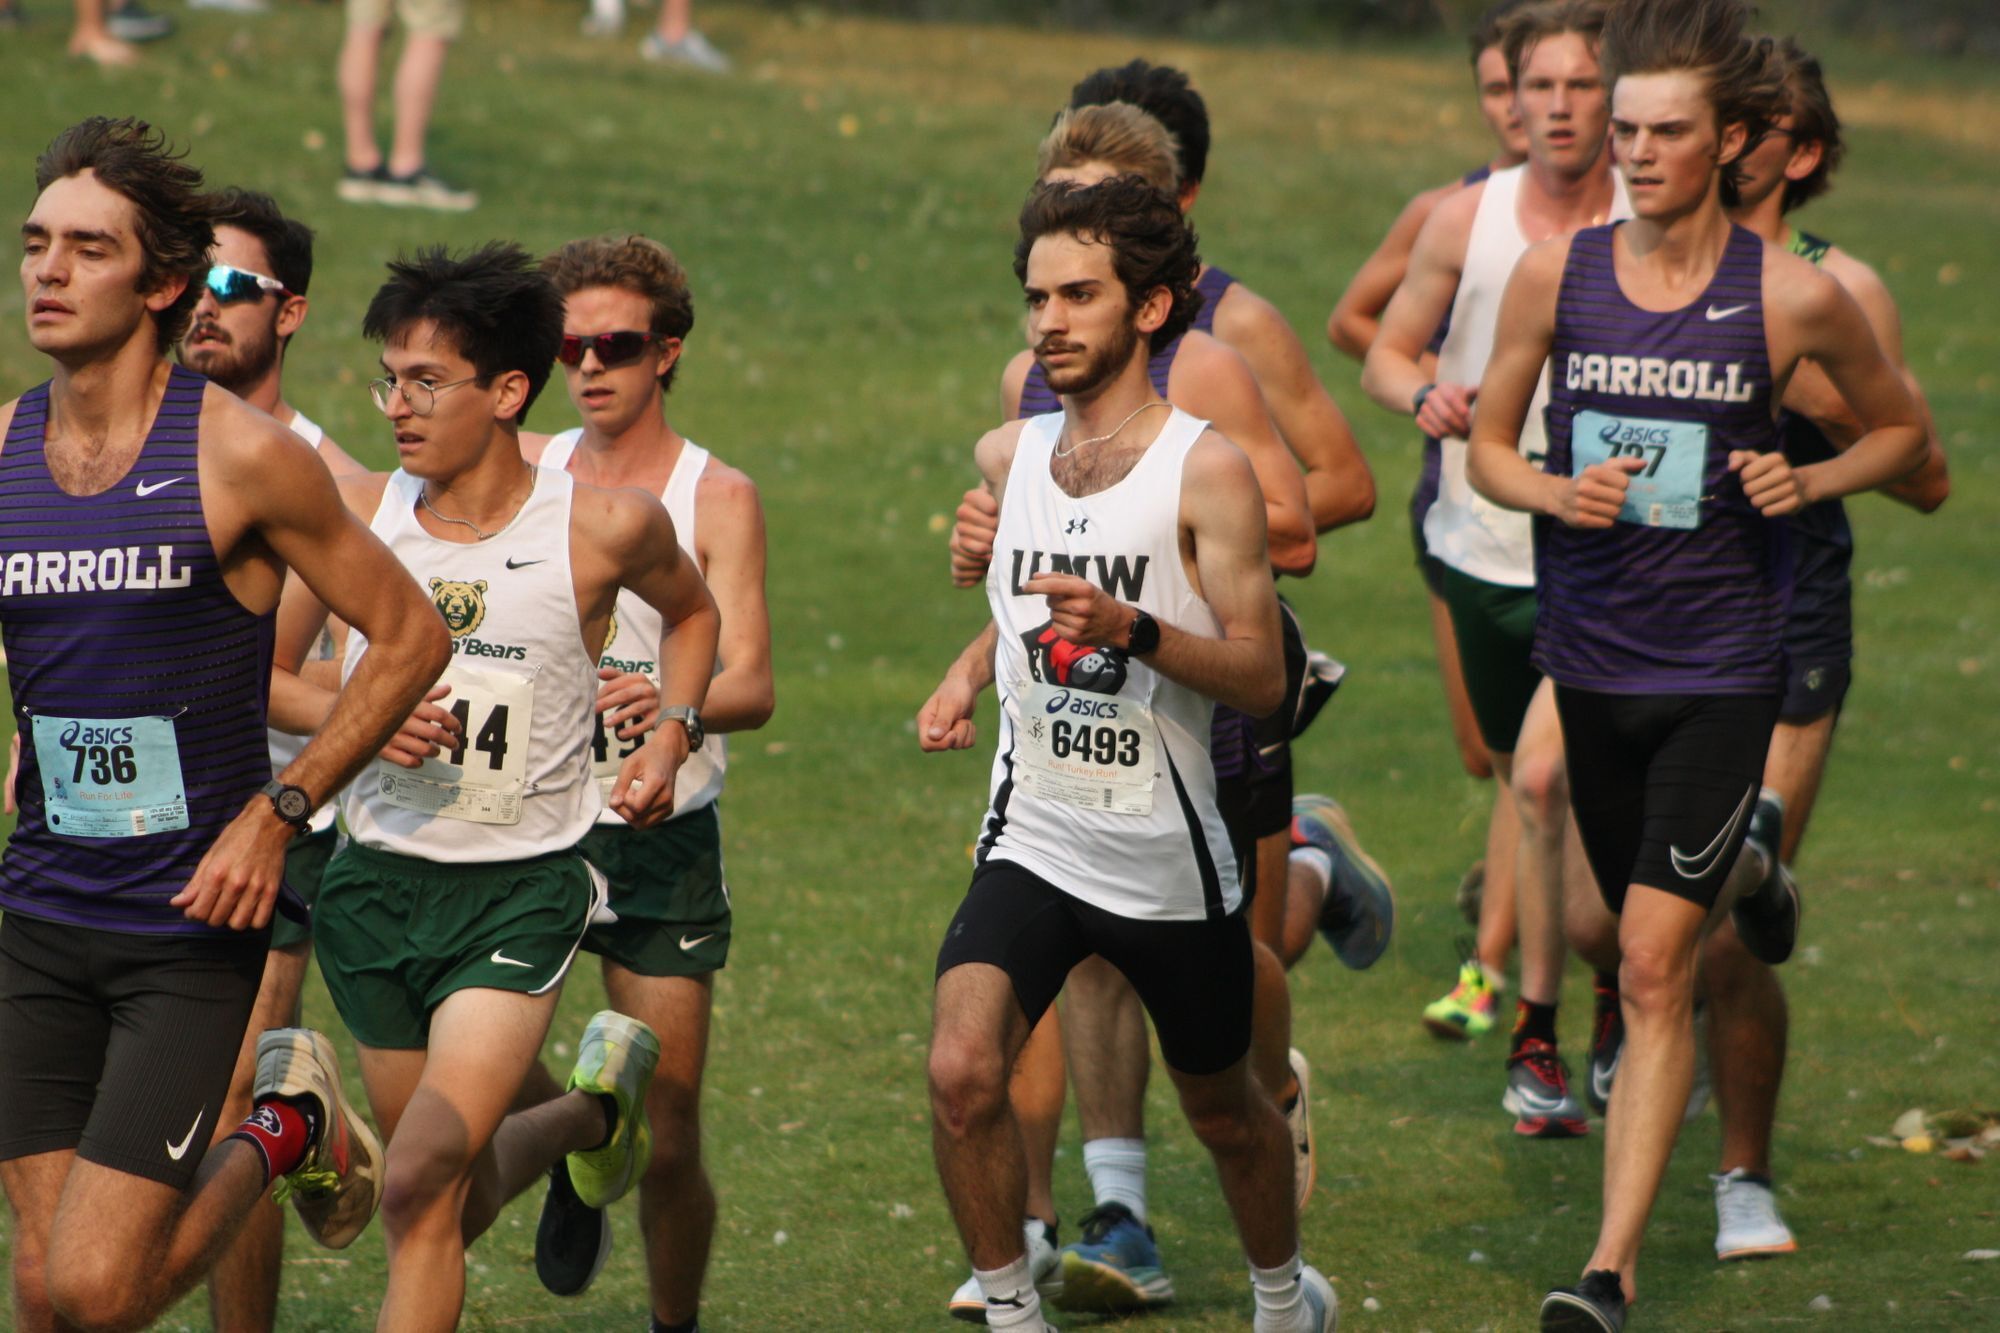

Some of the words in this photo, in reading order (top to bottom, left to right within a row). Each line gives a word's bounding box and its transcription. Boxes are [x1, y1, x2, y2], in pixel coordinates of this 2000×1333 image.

[1566, 352, 1753, 402] CARROLL
[1620, 426, 1671, 445] asics
[0, 545, 191, 596] ARROLL
[1012, 549, 1150, 602] UMW
[1069, 697, 1119, 719] asics
[82, 726, 133, 745] asics
[1051, 719, 1141, 767] 6493
[66, 744, 138, 786] 736
[80, 791, 96, 800] Run
